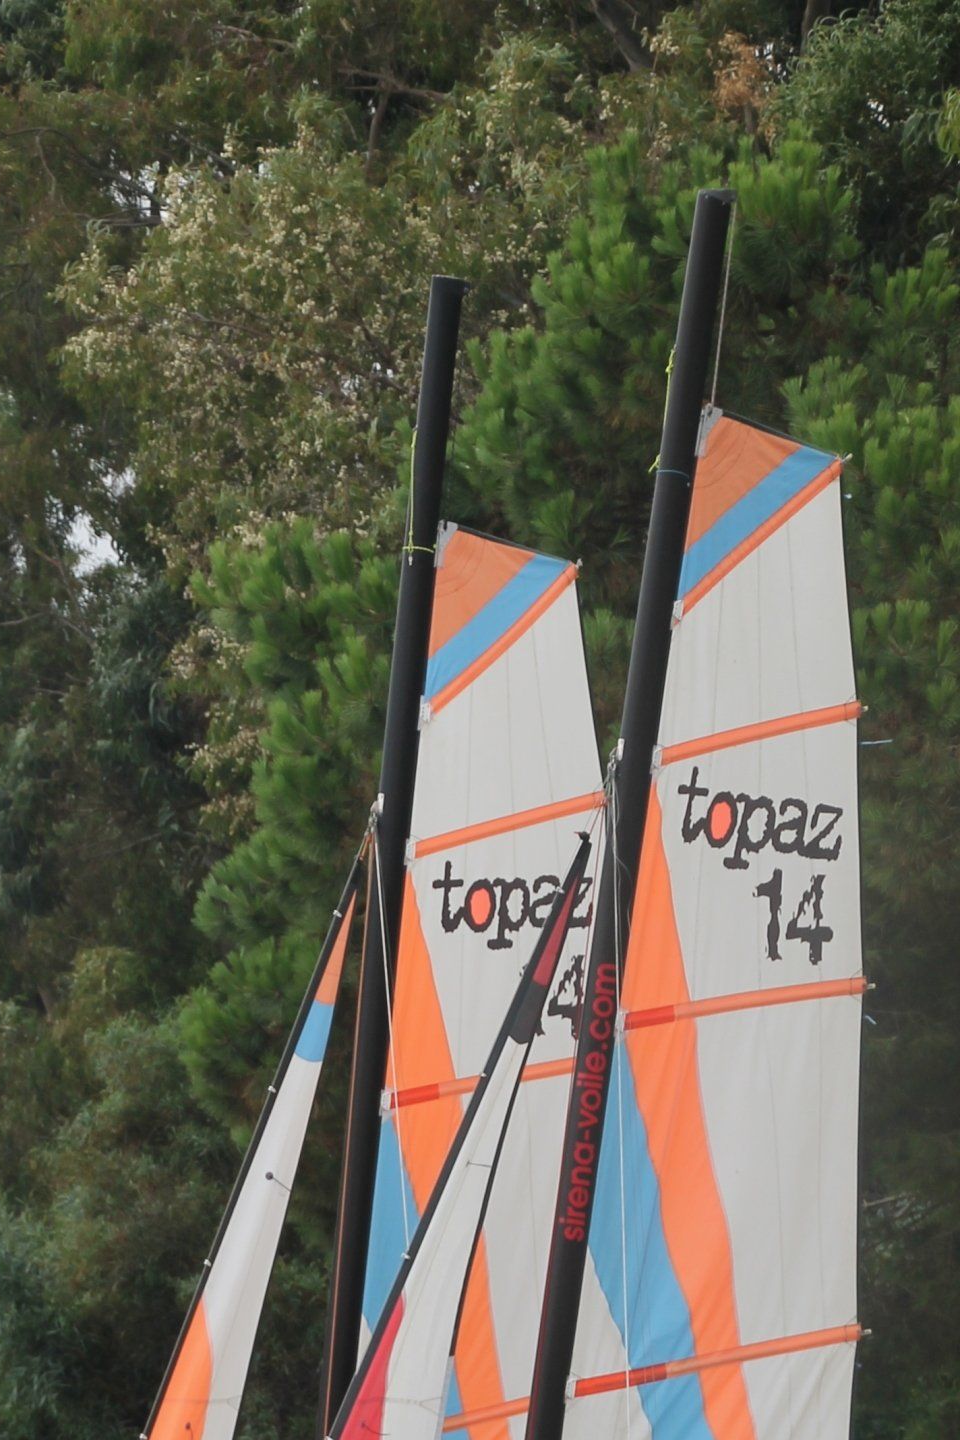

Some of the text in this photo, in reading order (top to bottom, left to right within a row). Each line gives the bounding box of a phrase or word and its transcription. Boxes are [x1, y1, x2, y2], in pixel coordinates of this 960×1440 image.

[677, 766, 843, 870] topaz
[432, 860, 593, 950] topaz
[752, 868, 833, 965] 14
[559, 963, 617, 1242] sirena-voile.com
